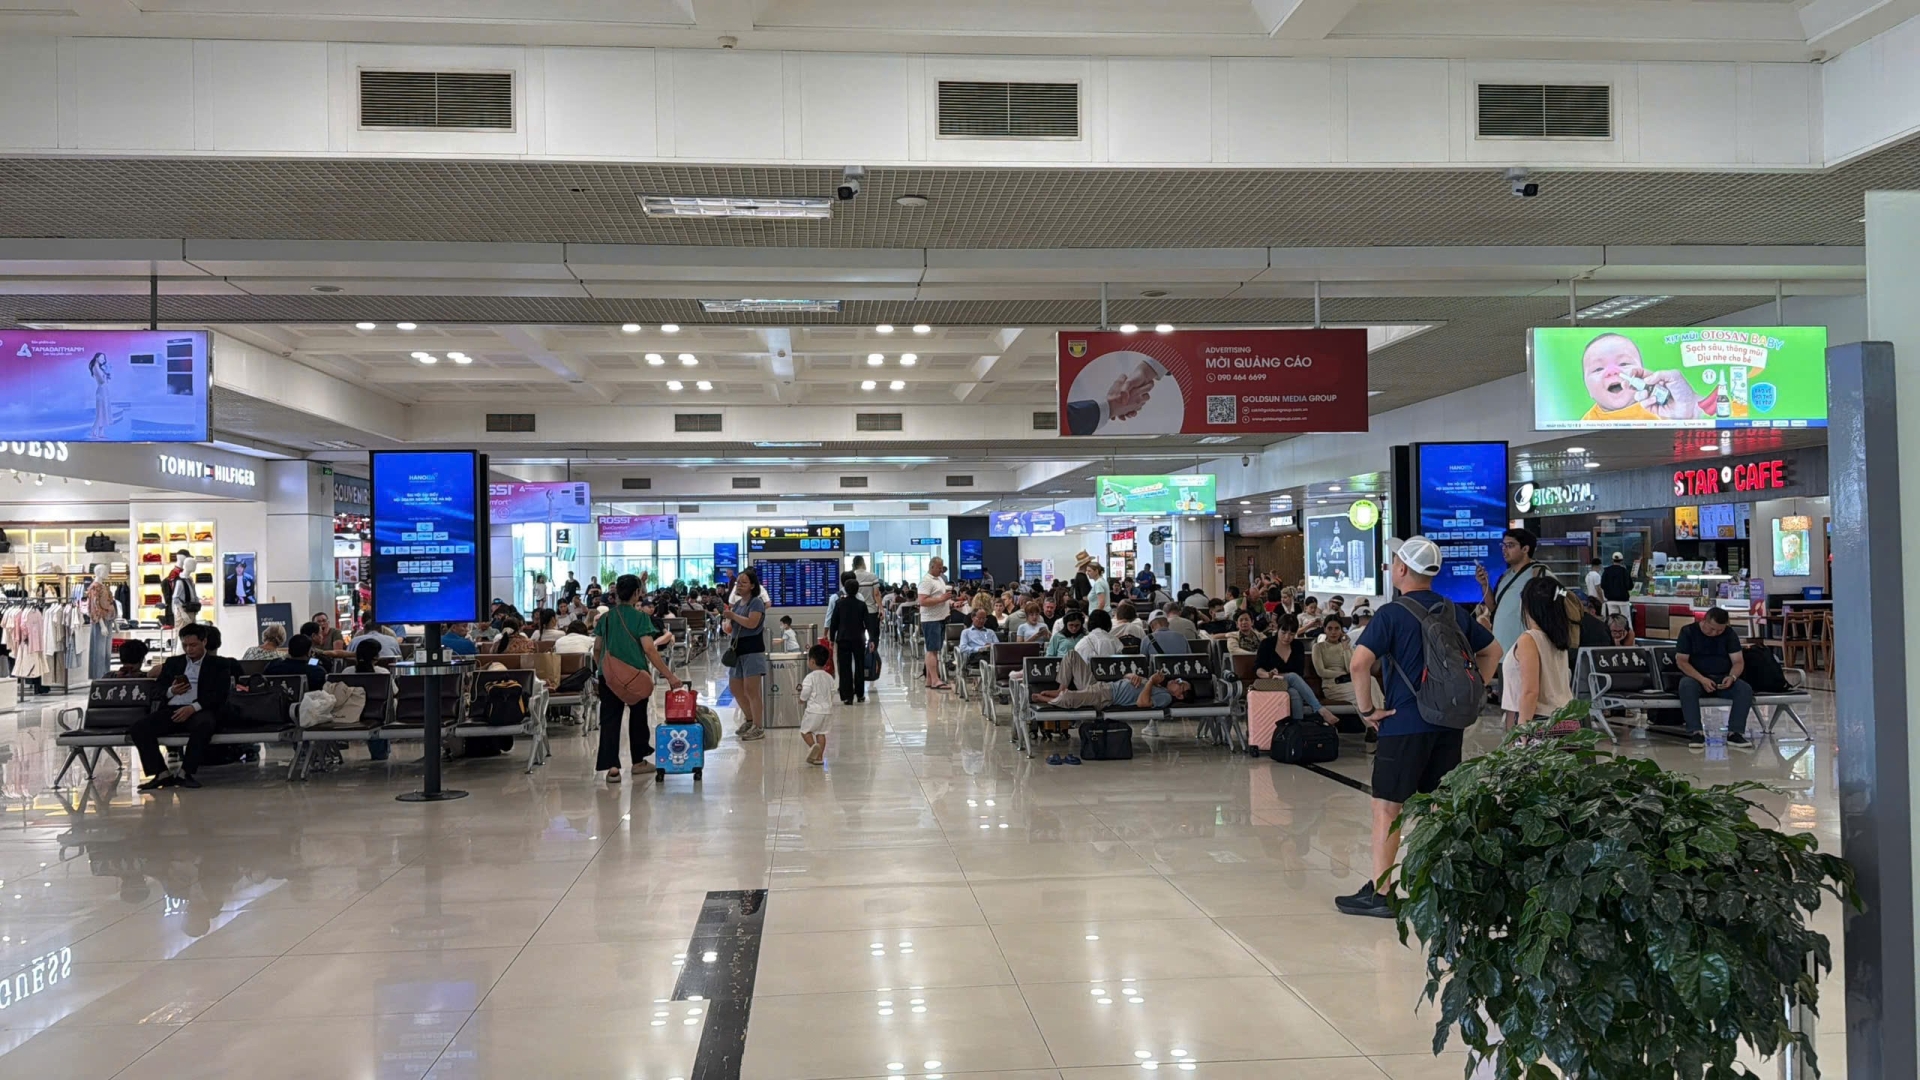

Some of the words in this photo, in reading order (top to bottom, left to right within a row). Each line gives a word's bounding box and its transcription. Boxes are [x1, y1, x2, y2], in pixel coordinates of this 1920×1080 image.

[1701, 330, 1748, 342] OTOSAN
[1752, 334, 1783, 350] BABY
[1686, 344, 1706, 352] Sạch
[1708, 344, 1724, 352] sâu,
[1726, 344, 1748, 354] thông
[1749, 348, 1763, 356] mũi
[1206, 356, 1230, 368] MỜI
[1234, 354, 1281, 368] QUẢNG
[1284, 354, 1312, 368] CÁO
[1697, 354, 1711, 362] Dịu
[1713, 354, 1727, 362] nhẹ
[1742, 354, 1752, 363] bé
[160, 454, 203, 478] TOMMY
[214, 464, 256, 486] HILFIGER
[1674, 468, 1719, 496] STAR
[1734, 460, 1784, 492] CAFE
[559, 530, 566, 538] 2
[770, 529, 776, 537] 2
[816, 528, 821, 536] 1
